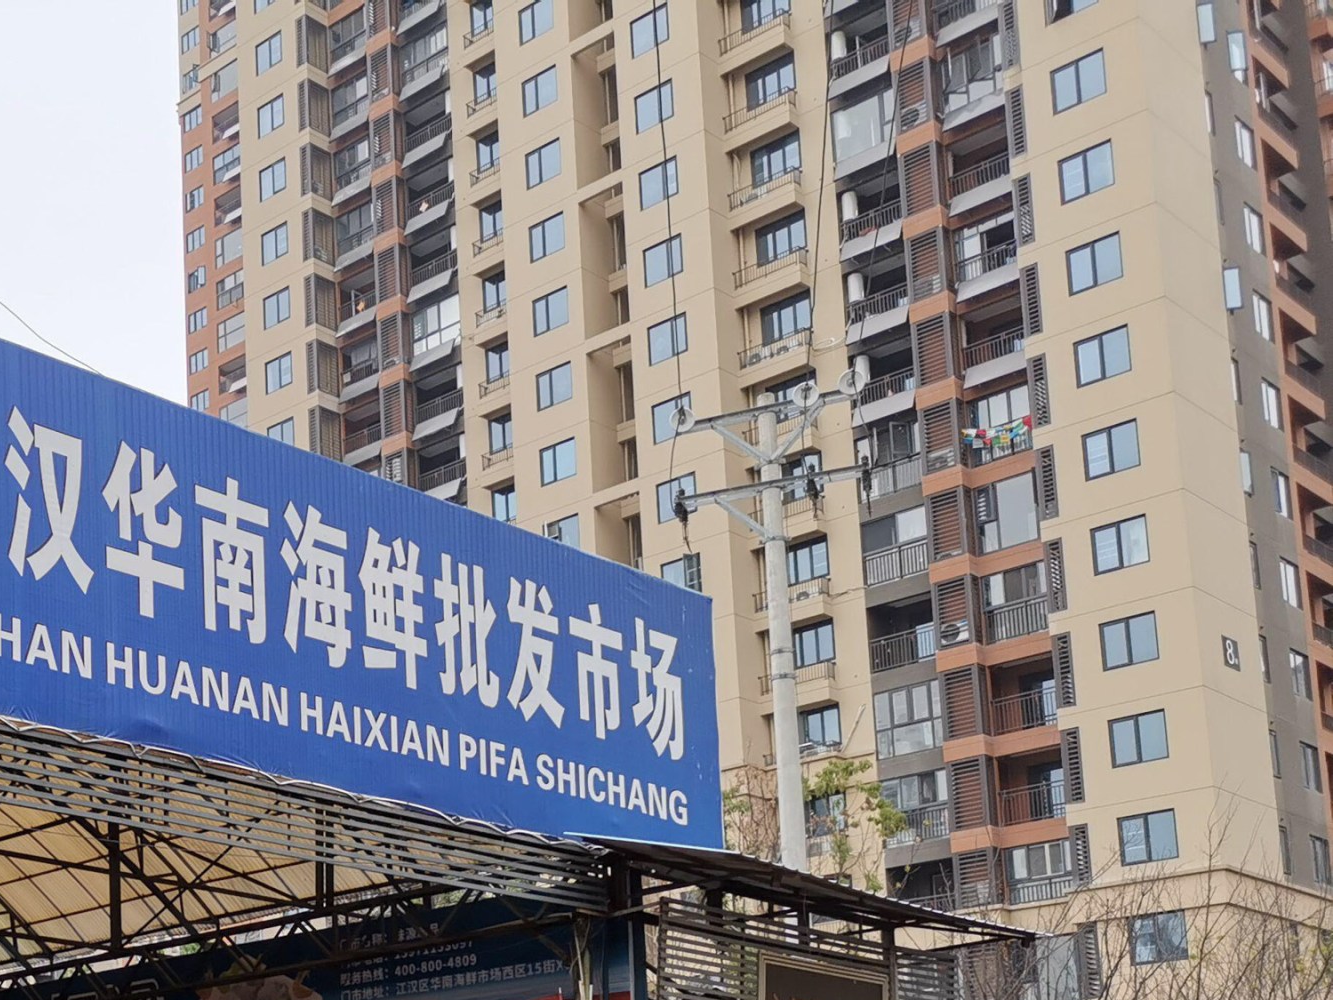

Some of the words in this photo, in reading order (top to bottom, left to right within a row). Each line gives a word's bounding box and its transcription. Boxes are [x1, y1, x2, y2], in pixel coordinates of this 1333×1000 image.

[106, 641, 289, 728] HUANAN
[300, 692, 450, 767] HAIXIAN
[459, 732, 529, 786] PIFA
[536, 753, 688, 826] SHICHANG
